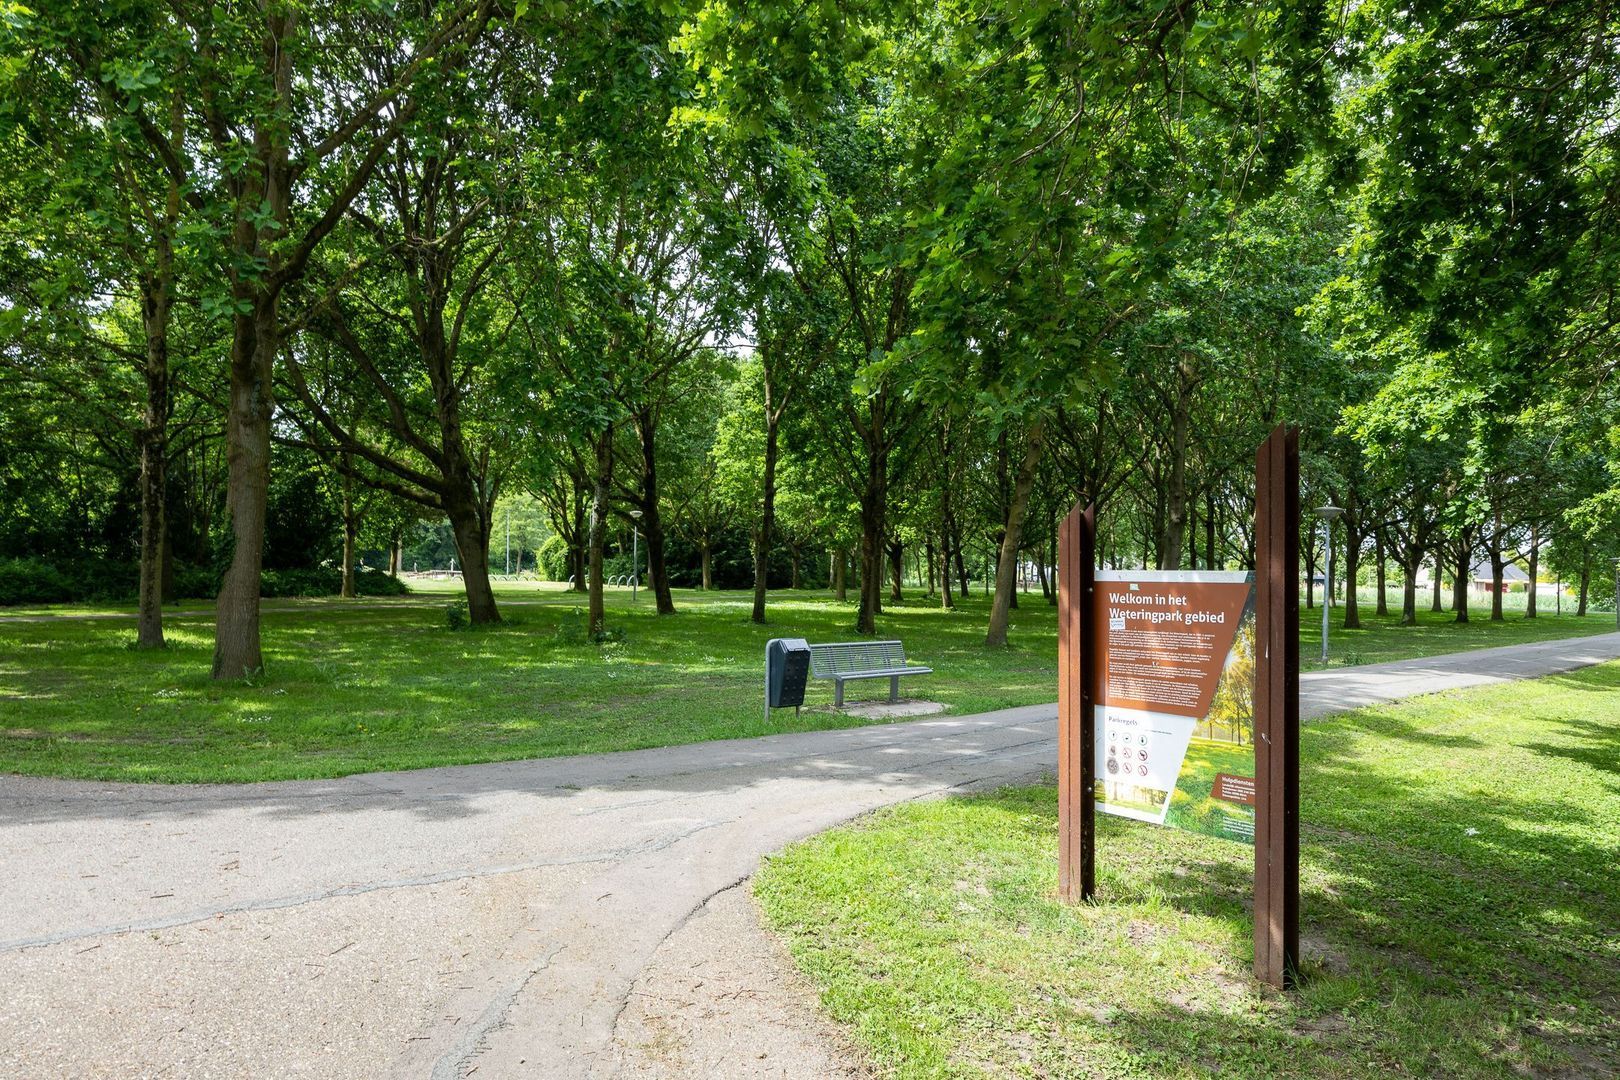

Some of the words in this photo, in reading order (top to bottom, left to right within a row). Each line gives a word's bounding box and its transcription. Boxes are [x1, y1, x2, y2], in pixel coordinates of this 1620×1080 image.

[1109, 593, 1153, 605] Welkom
[1155, 594, 1166, 605] in
[1168, 594, 1187, 606] het
[1109, 608, 1183, 624] Weteringpark
[1185, 611, 1225, 624] gebied
[1108, 715, 1138, 726] Parkregels
